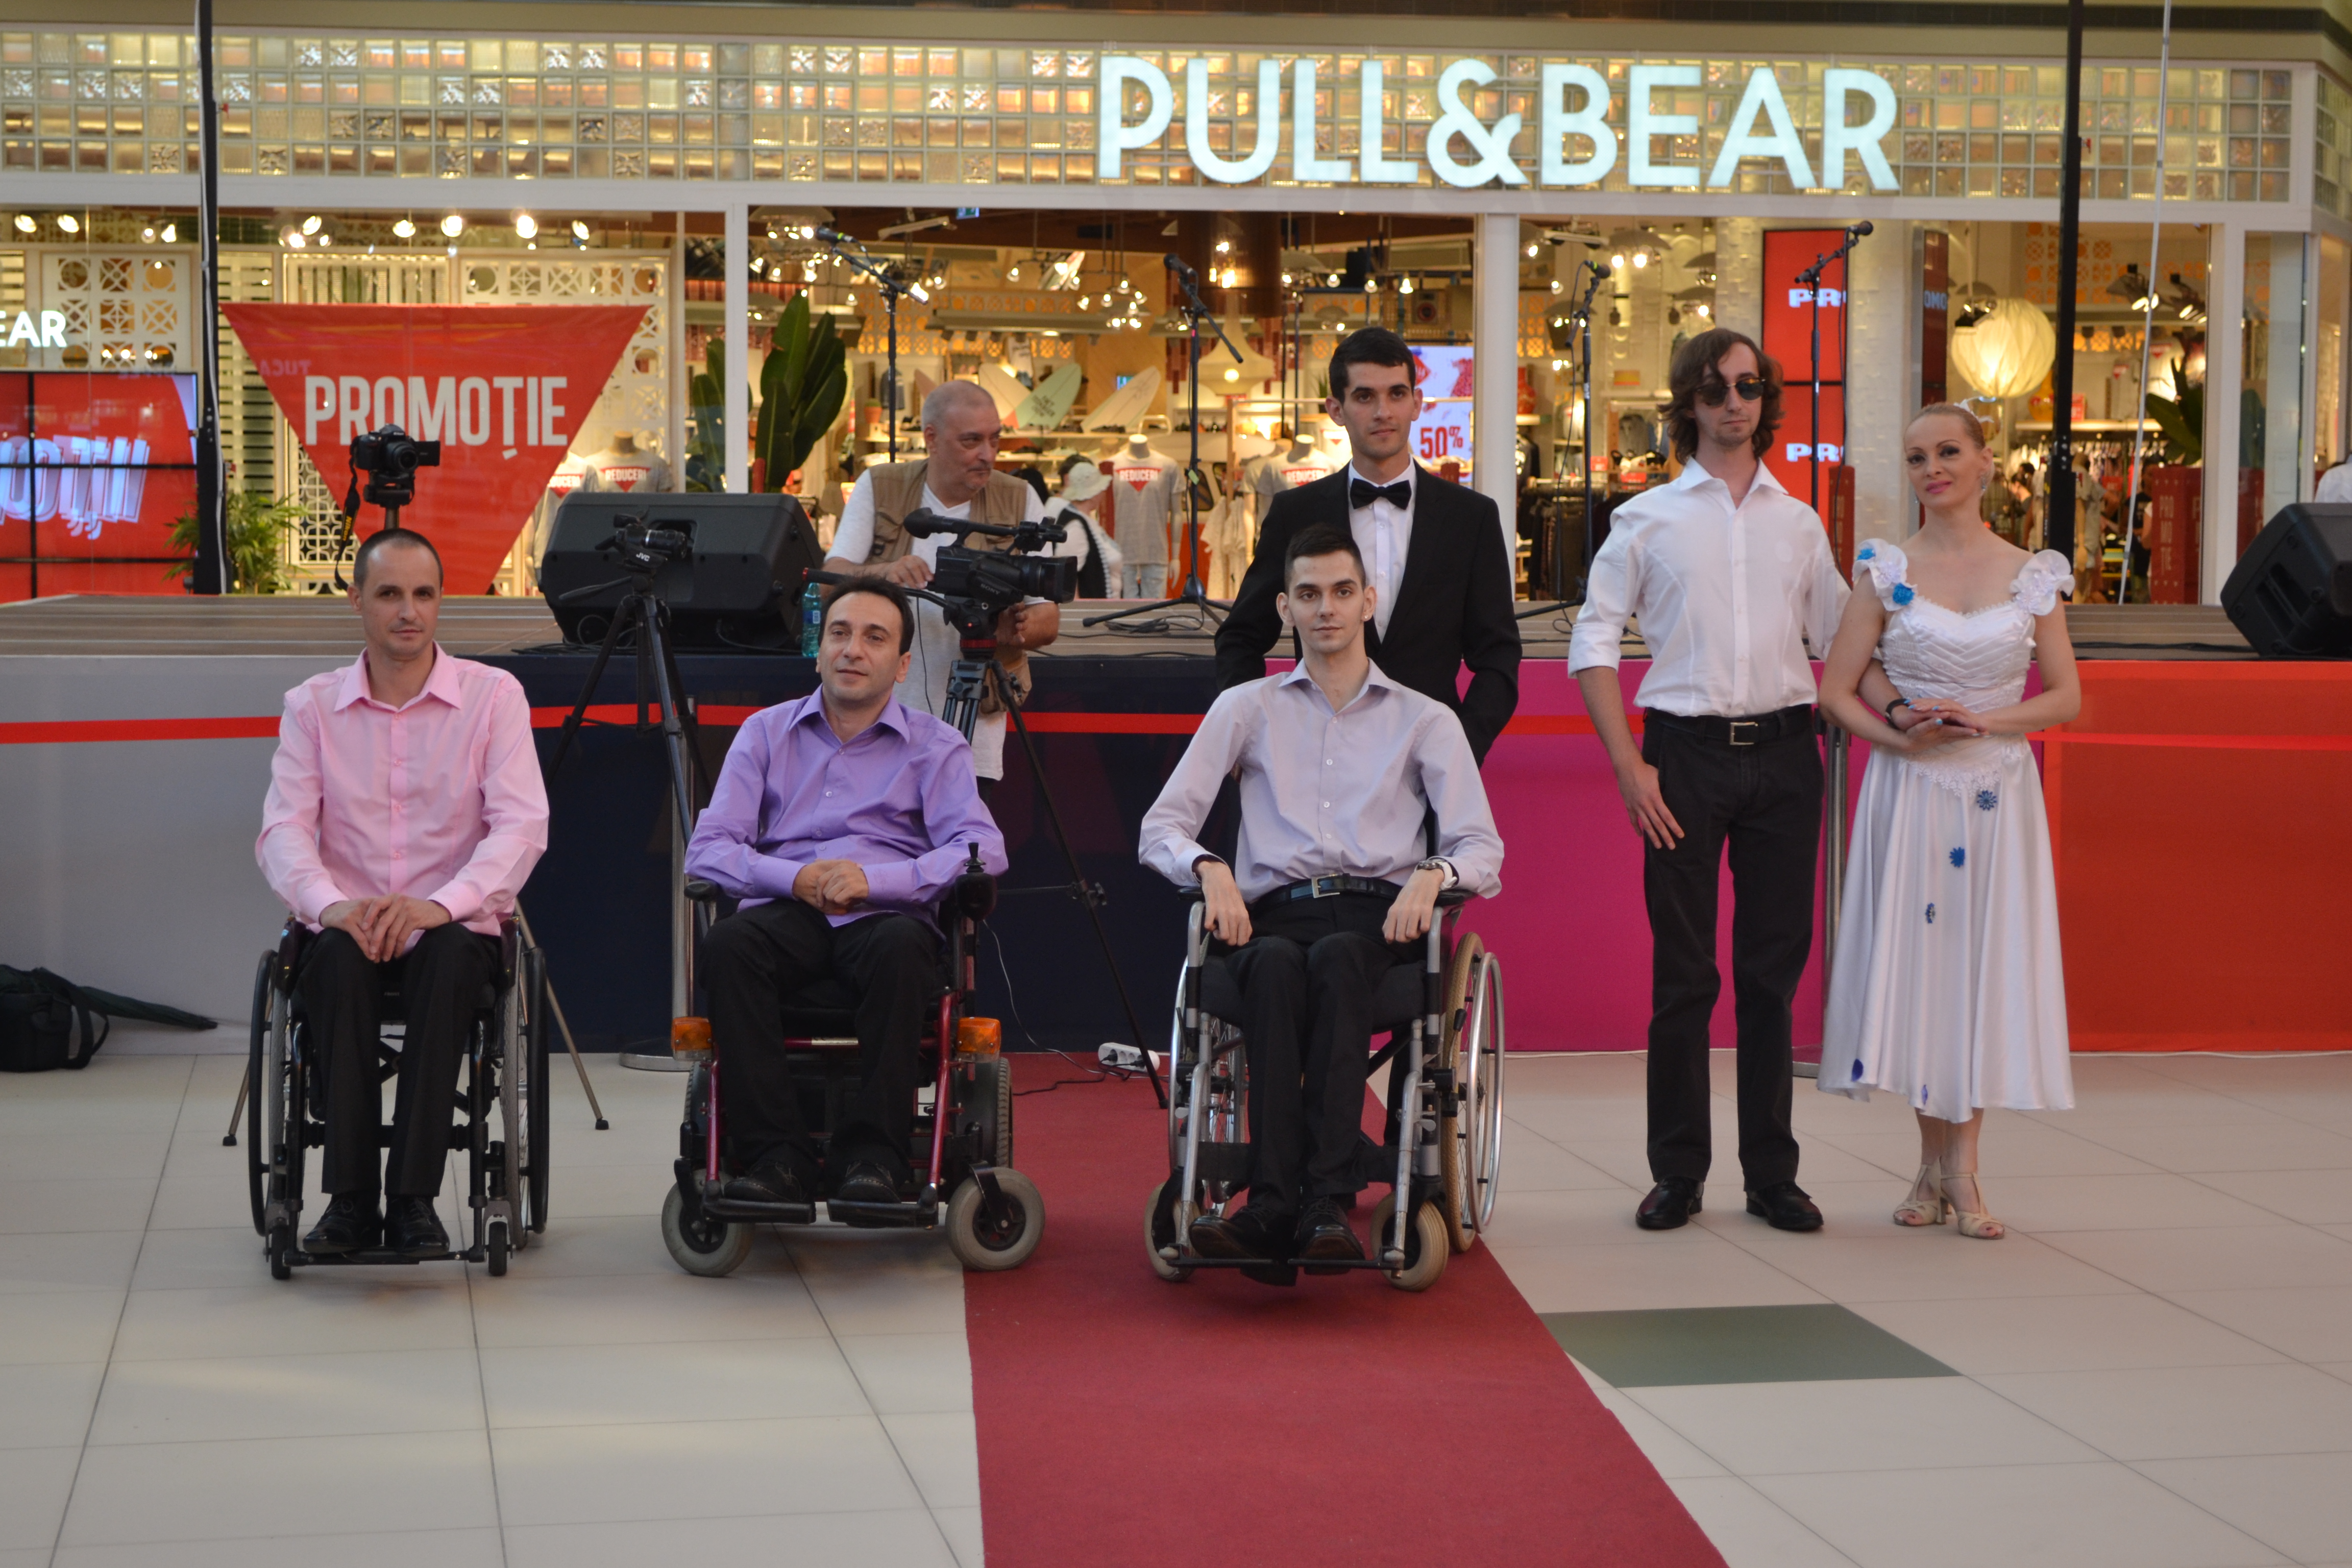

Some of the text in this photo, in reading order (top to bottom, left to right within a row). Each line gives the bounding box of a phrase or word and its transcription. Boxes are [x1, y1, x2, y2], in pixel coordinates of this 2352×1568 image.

[1098, 56, 1900, 190] PULL&BEAR
[1788, 288, 1846, 307] PR
[305, 375, 568, 460] PROMOȚIE
[1420, 425, 1464, 459] 50%
[1786, 443, 1845, 462] PR
[605, 468, 647, 481] REDUCERI
[1119, 469, 1158, 481] REDUCERI
[636, 552, 650, 562] JVC
[981, 583, 1000, 595] SONY
